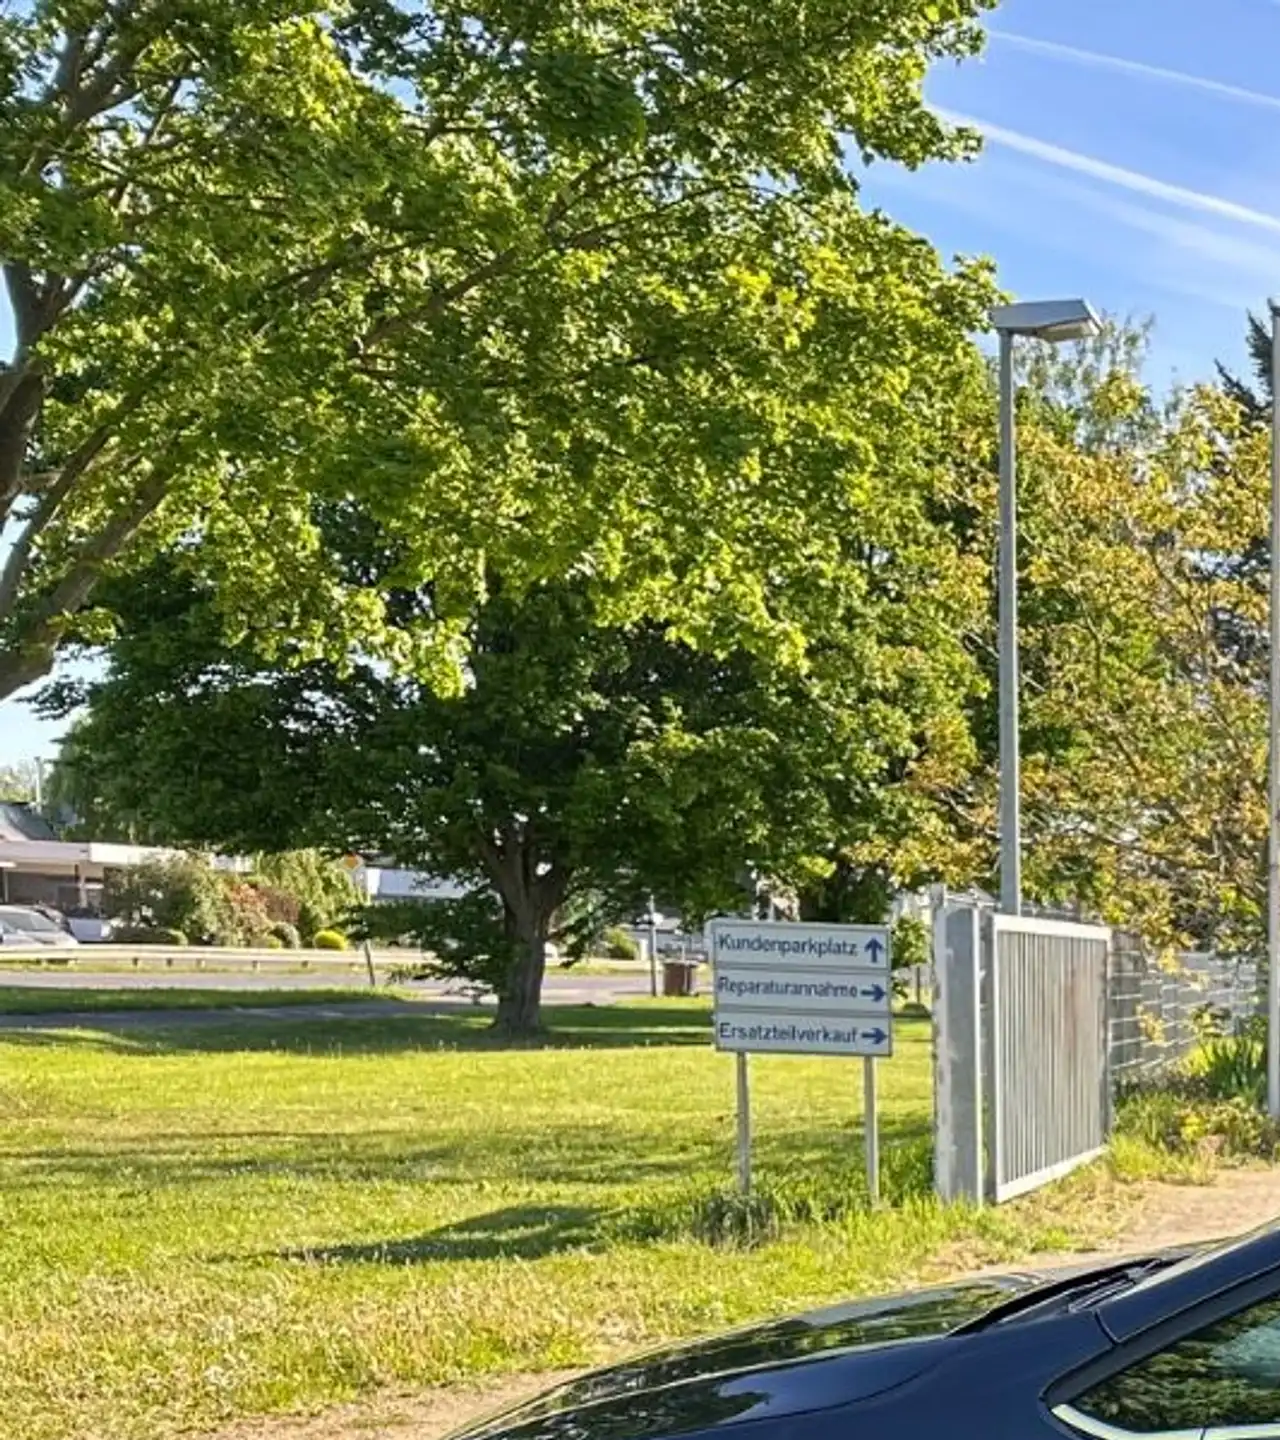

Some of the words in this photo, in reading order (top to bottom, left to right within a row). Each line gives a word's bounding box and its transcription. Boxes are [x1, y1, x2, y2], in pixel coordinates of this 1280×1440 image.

[718, 933, 858, 957] Kundenparkplatz
[718, 976, 858, 998] Reparaturannahme
[719, 1022, 858, 1044] Ersatzteilverkauf
